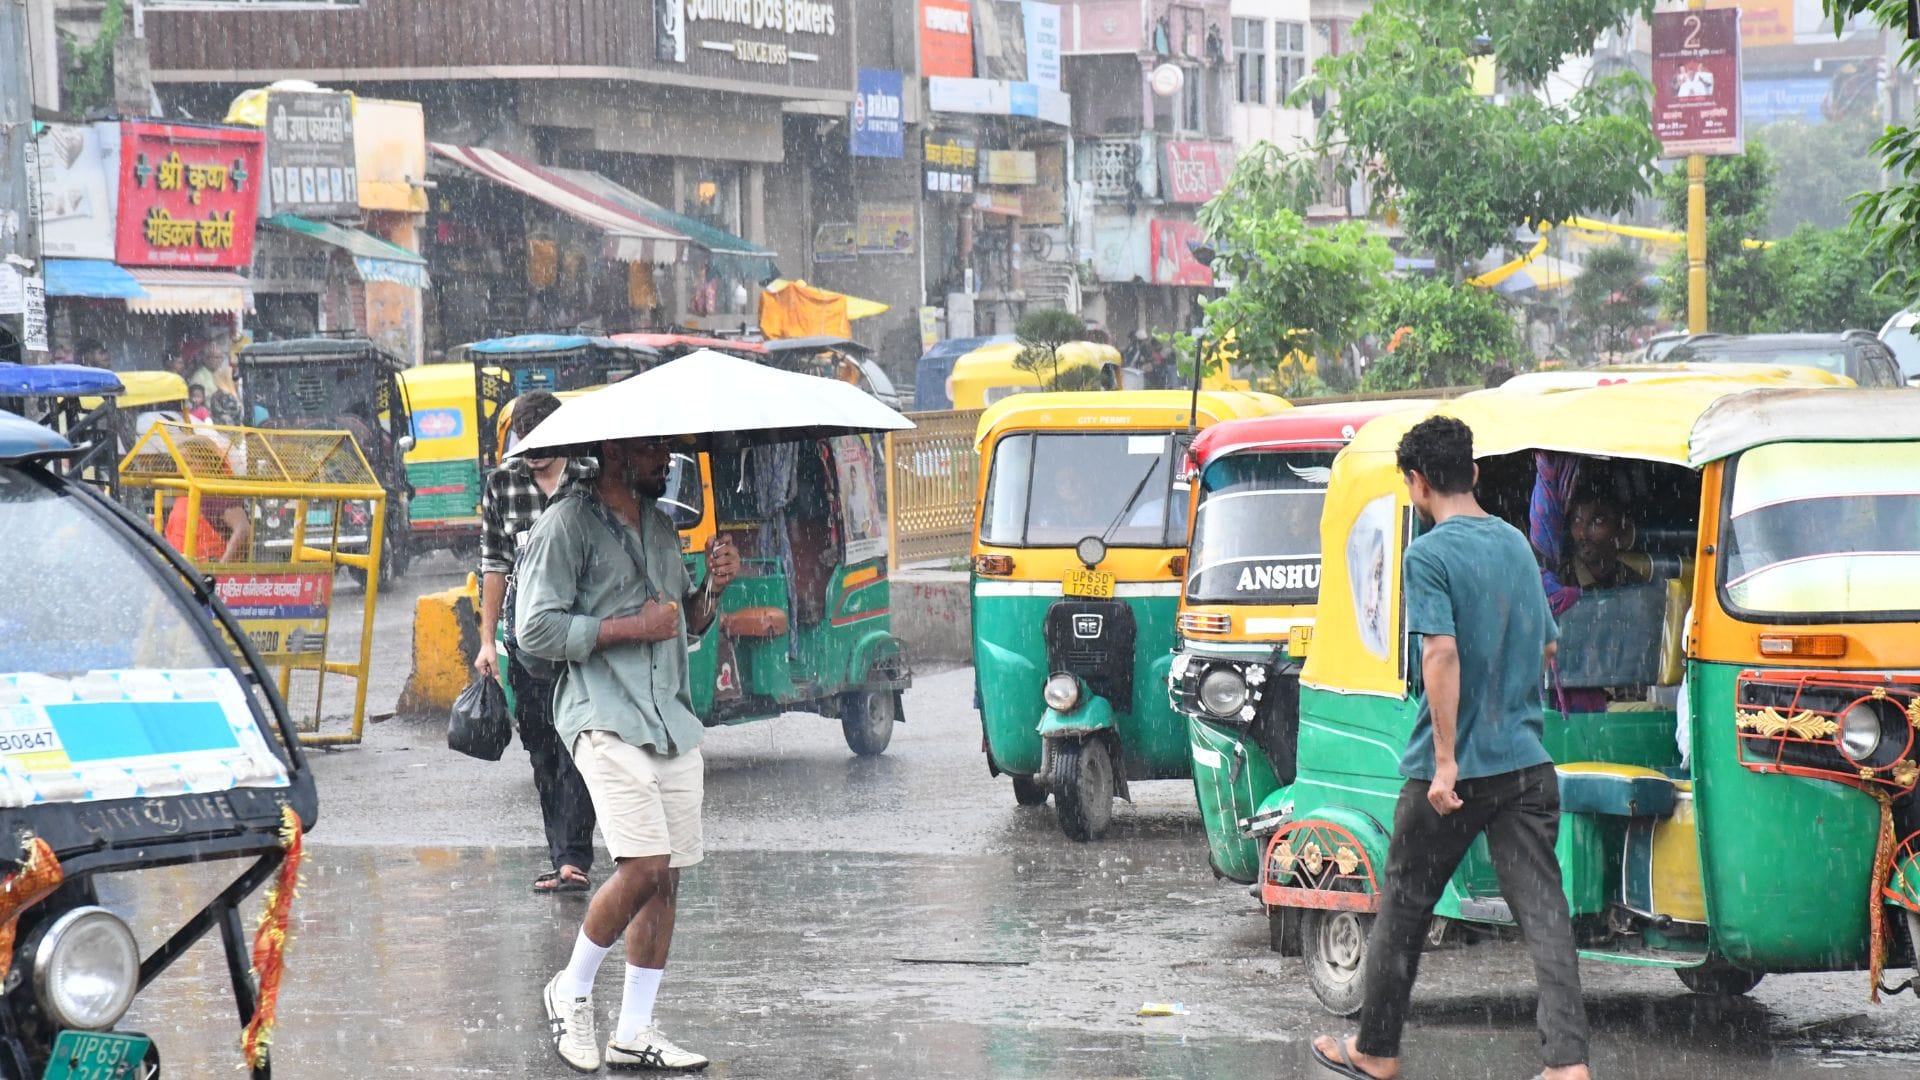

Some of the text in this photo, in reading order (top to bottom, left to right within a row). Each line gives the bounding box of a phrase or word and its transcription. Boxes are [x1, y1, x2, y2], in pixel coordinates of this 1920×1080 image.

[753, 0, 784, 30] Das
[785, 0, 836, 36] Bakers
[1684, 15, 1701, 48] 2
[736, 39, 768, 62] SINCE
[158, 151, 228, 206] श्री कृष्ण
[146, 208, 197, 248] मेडिकल
[1078, 415, 1133, 425] CITY PERMIT
[1072, 571, 1109, 585] UP65D
[1072, 583, 1109, 597] T7565
[1078, 621, 1098, 633] RE
[79, 806, 142, 833] CITY
[179, 795, 235, 821] LIFE
